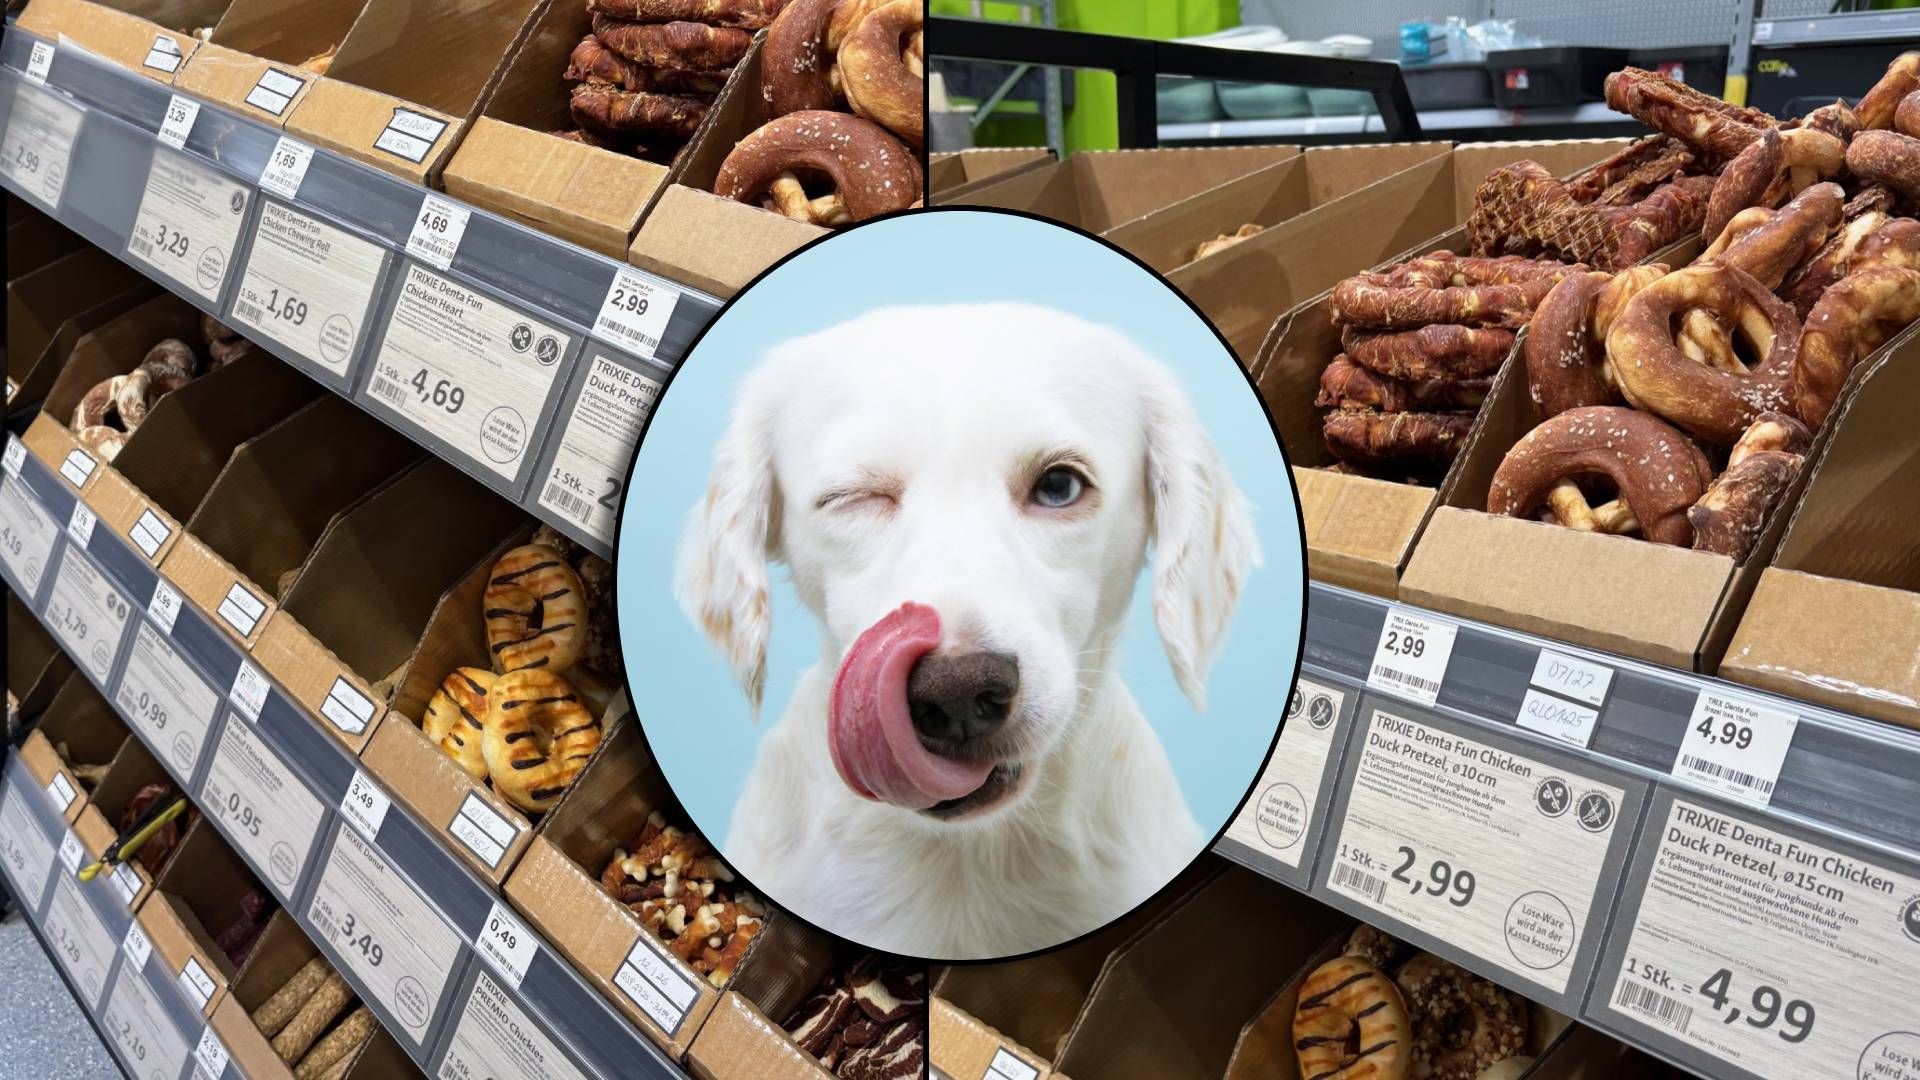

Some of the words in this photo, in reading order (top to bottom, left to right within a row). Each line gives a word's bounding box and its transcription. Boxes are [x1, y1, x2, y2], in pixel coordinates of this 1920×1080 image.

[168, 108, 185, 123] 3,29
[16, 144, 39, 172] 2,99
[275, 151, 296, 169] 1,69
[262, 217, 287, 234] Chicken
[288, 226, 315, 247] Chewing
[317, 239, 330, 253] Roll
[266, 204, 286, 219] TRIXIE
[288, 212, 308, 229] Denta
[308, 223, 320, 234] Fun
[421, 212, 448, 233] 4,69
[155, 224, 189, 258] 3,29
[406, 283, 438, 305] Chicken
[439, 299, 464, 318] Heart
[411, 269, 438, 289] TRIXIE
[440, 281, 465, 301] Denta
[466, 295, 483, 310] Fun
[611, 289, 648, 316] 2,99
[266, 288, 307, 326] 1,69
[378, 362, 383, 372] 1
[385, 366, 400, 383] Stk.
[590, 375, 617, 396] Duck
[597, 360, 629, 384] TRIXIE
[411, 368, 465, 414] 4,69
[553, 468, 560, 478] 1
[562, 472, 583, 493] Stk.
[2, 527, 22, 556] 4,19
[64, 607, 87, 640] 1,79
[1384, 631, 1425, 658] 2,99
[139, 692, 167, 729] 0,99
[1745, 708, 1758, 718] Fun
[1376, 714, 1415, 738] TRIXIE
[1416, 728, 1451, 751] Denta
[1454, 741, 1477, 760] Fun
[1480, 750, 1532, 778] Chicken
[1696, 716, 1753, 749] 4,99
[1370, 732, 1400, 753] Duck
[1402, 744, 1448, 773] Pretzel,
[352, 783, 374, 809] 3,49
[228, 792, 262, 837] 0,95
[342, 825, 364, 856] TRIXIE
[363, 847, 384, 873] Donut
[1339, 844, 1347, 856] 1
[1350, 848, 1374, 870] Stk.
[1667, 827, 1708, 854] Duck
[1712, 844, 1778, 881] Pretzel,
[1676, 806, 1730, 836] TRIXIE
[1731, 826, 1782, 856] Denta
[1785, 844, 1818, 868] Fun
[1822, 857, 1895, 893] Chicken
[1391, 845, 1476, 907] 2,99
[1662, 848, 1760, 891] Ergänzungsfuttermittel
[1761, 882, 1775, 894] für
[1776, 888, 1824, 914] Junghunde
[1824, 906, 1836, 917] ab
[1838, 910, 1859, 926] dem
[1668, 860, 1724, 888] Lebensmonat
[1724, 879, 1740, 894] und
[1741, 888, 1809, 919] ausgewachsene
[1811, 913, 1842, 931] Hunde
[341, 912, 383, 967] 3,49
[490, 918, 516, 949] 0,49
[1508, 927, 1531, 945] Kassa
[1531, 935, 1565, 958] kassiert
[1516, 917, 1536, 934] wird
[1536, 924, 1547, 936] an
[1548, 928, 1563, 942] der
[481, 974, 508, 1008] TRIXIE
[1626, 958, 1636, 974] 1
[1642, 964, 1675, 991] Stk.
[1682, 984, 1693, 994] =
[1699, 968, 1816, 1044] 4,99
[475, 985, 509, 1024] PREMIO
[510, 1022, 544, 1063] Chickies
[121, 1022, 146, 1062] 2,19
[203, 1036, 218, 1059] 2,19
[1882, 1046, 1908, 1066] Lose
[1875, 1061, 1902, 1079] wird
